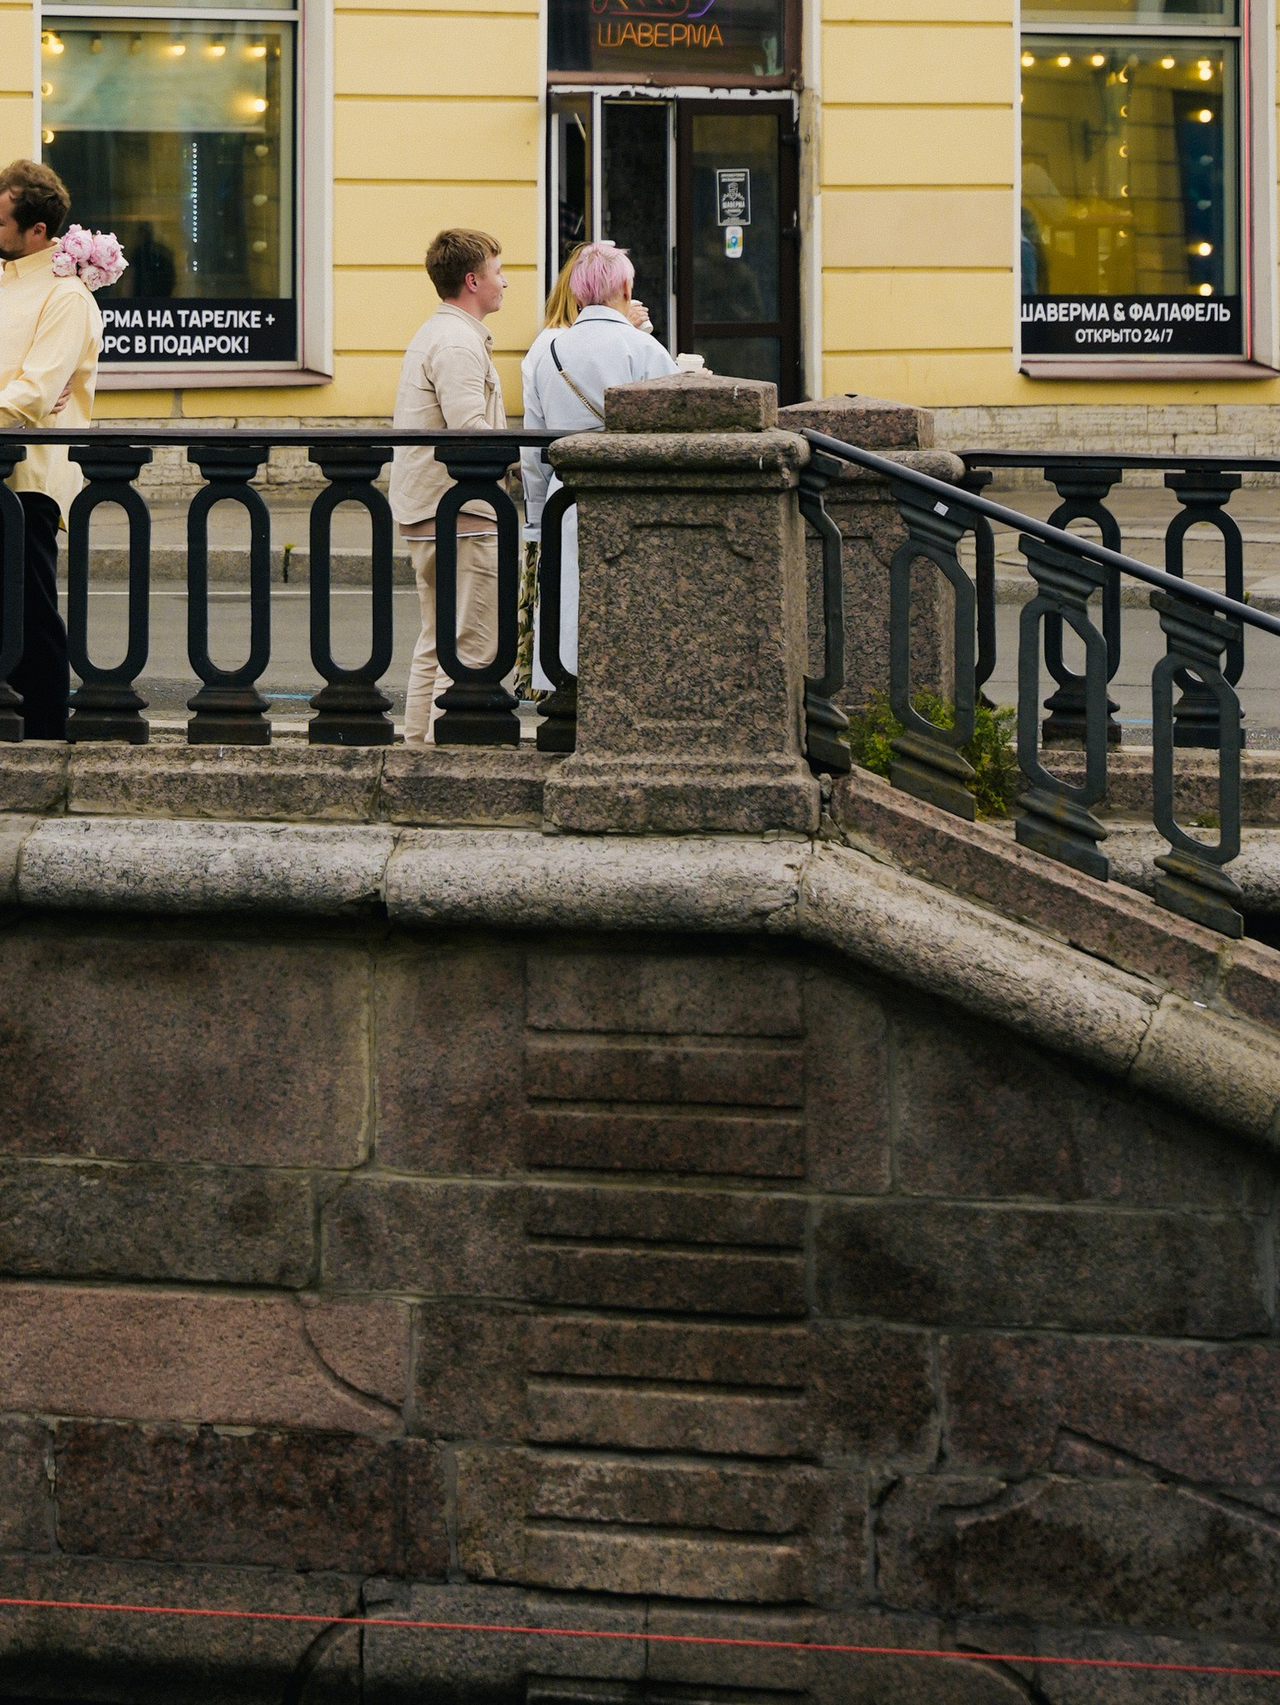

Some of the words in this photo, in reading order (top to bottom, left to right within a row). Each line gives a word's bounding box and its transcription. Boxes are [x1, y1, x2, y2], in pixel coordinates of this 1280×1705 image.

[597, 21, 724, 48] ШАВЕРМА
[100, 309, 144, 328] РМА
[147, 309, 175, 328] НА
[177, 309, 262, 329] ТАРЕЛКЕ
[1020, 302, 1110, 322] ШАВЕРМА
[1113, 302, 1126, 322] &
[1129, 302, 1231, 322] ФАЛАФЕЛЬ
[134, 335, 147, 354] В
[150, 335, 250, 356] ПОДАРОК!
[1075, 328, 1142, 343] ОТКРЫТО
[1144, 328, 1174, 343] 24/7
